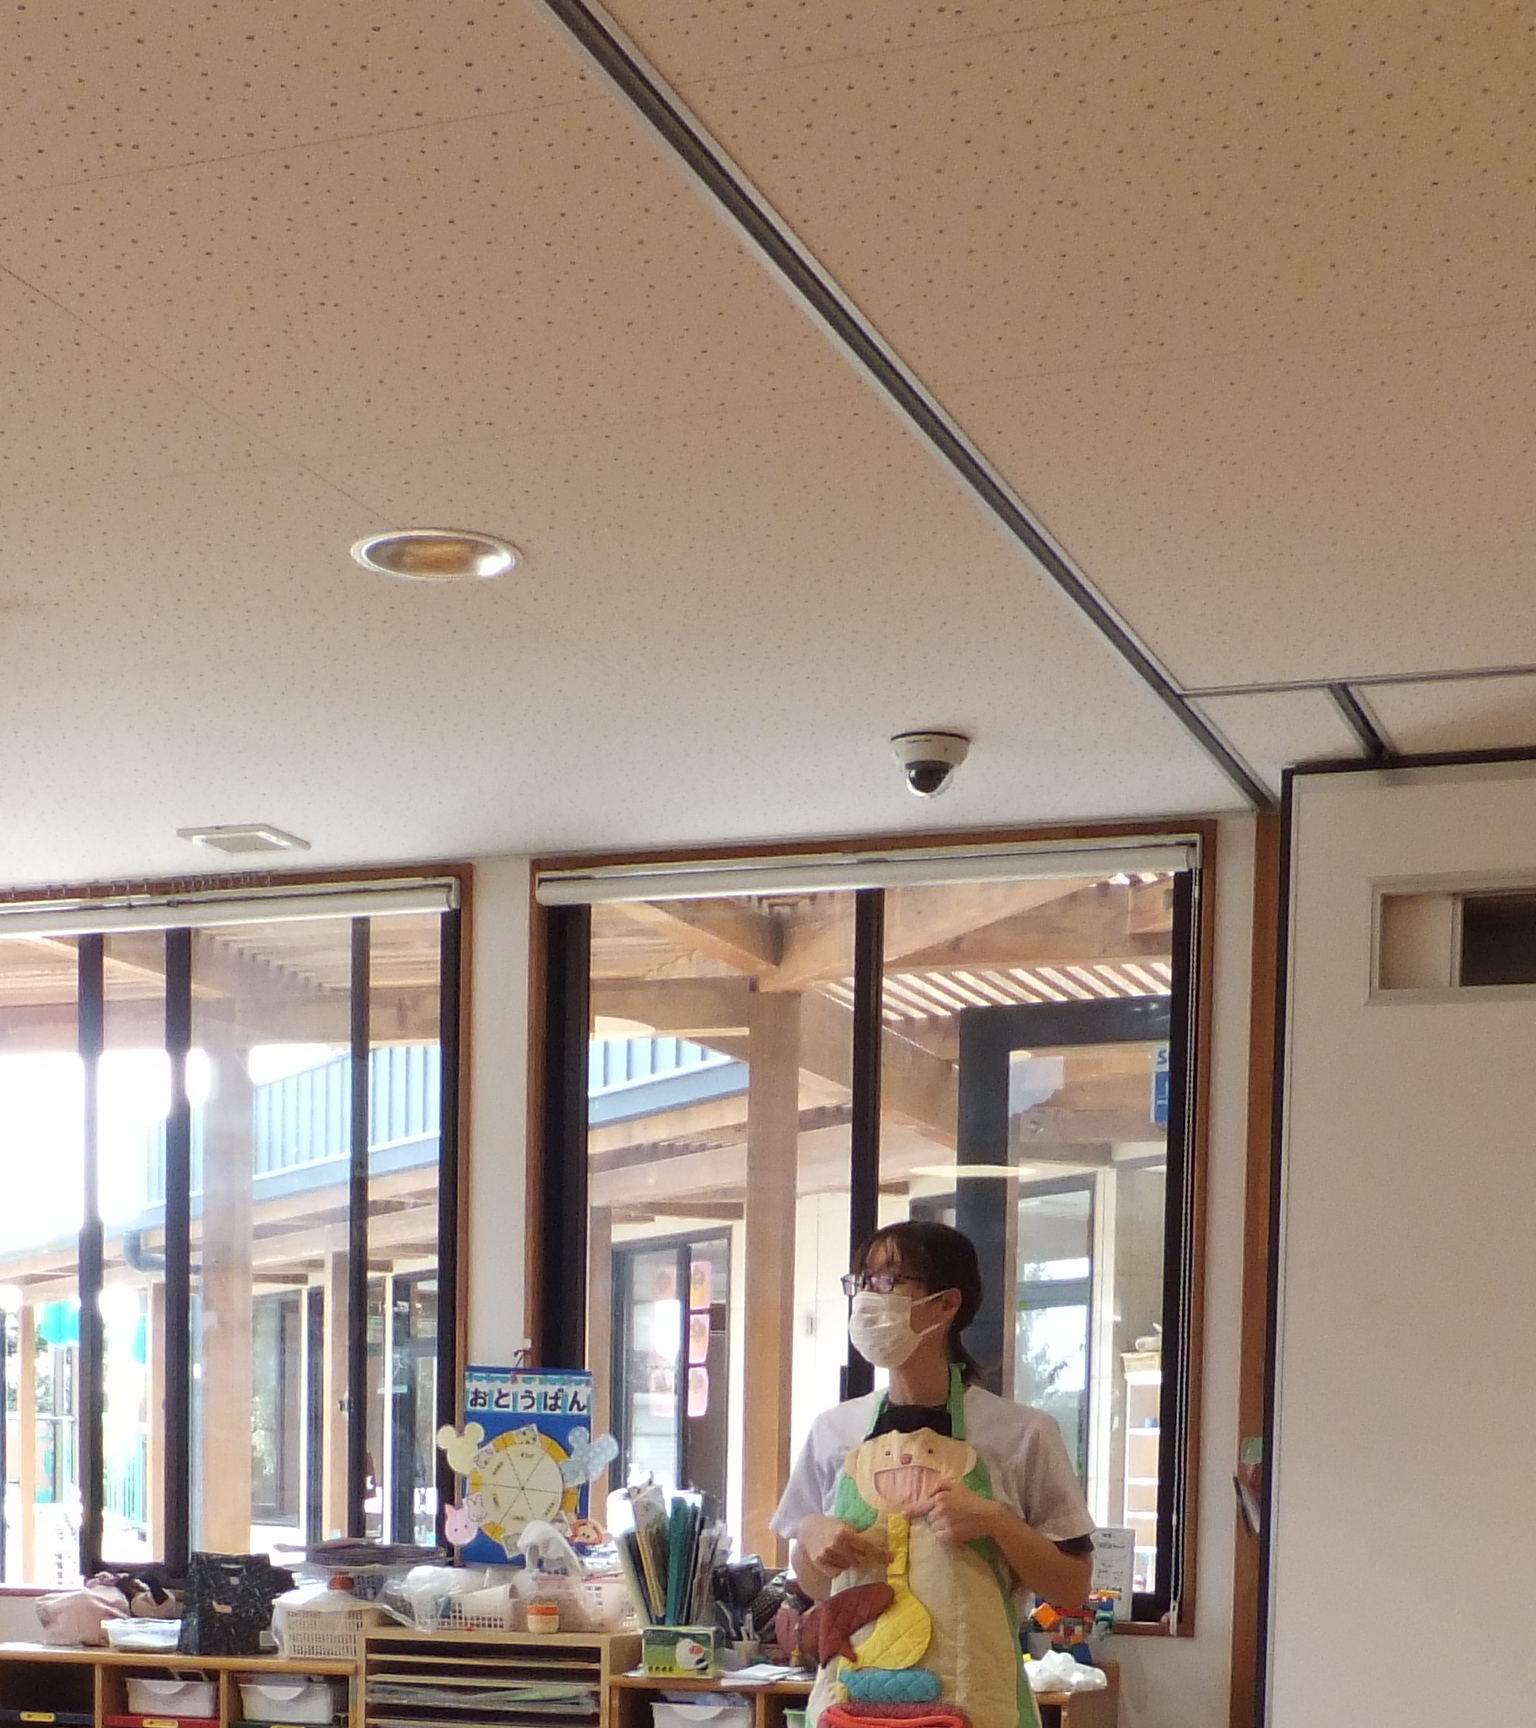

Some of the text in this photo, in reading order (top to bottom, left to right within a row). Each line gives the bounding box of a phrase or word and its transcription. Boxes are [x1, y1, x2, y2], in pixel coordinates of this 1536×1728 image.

[468, 1388, 588, 1413] おとうばん
